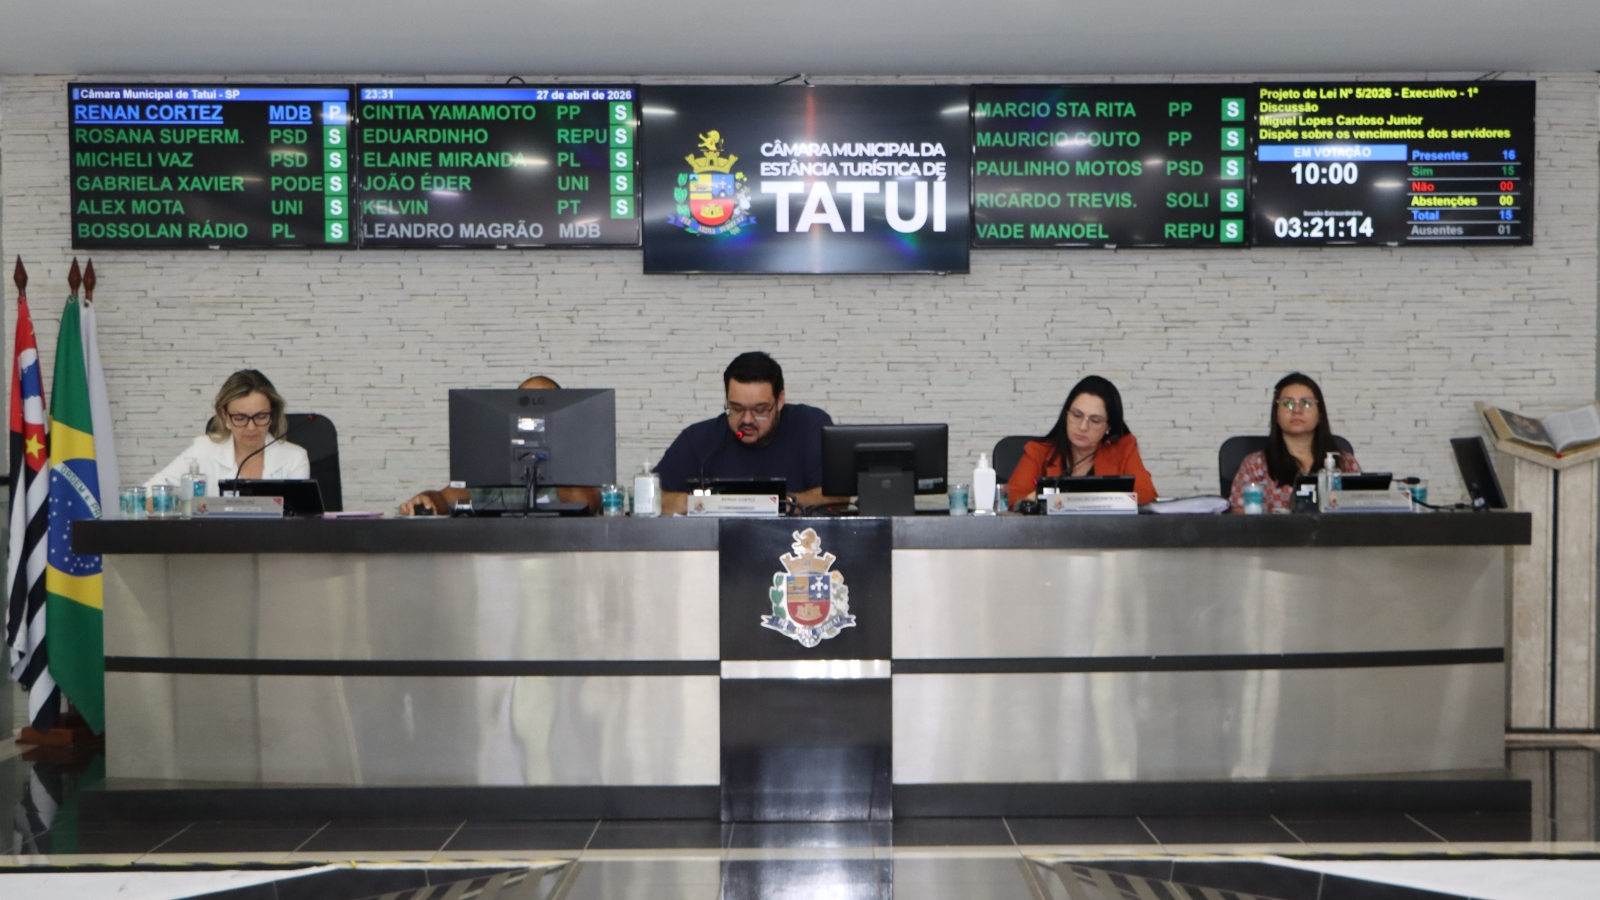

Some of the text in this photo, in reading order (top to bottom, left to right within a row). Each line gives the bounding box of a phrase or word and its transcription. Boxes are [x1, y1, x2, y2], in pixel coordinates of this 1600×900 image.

[81, 90, 120, 99] Câmara
[123, 89, 173, 100] Municipal
[176, 90, 188, 99] de
[225, 89, 240, 99] SP
[365, 90, 394, 99] 23:31
[536, 90, 632, 99] 27 de abril de 2026
[1260, 88, 1300, 101] Projeto
[1303, 88, 1317, 98] de
[1320, 88, 1337, 98] Lei
[1356, 88, 1392, 98] 5/2026
[1401, 88, 1457, 98] Executivo
[1467, 87, 1478, 98] 1ª
[74, 104, 341, 120] RENAN CORTEZ MDB P
[363, 105, 626, 120] CINTIA YAMAMOTO PP S
[976, 102, 1239, 117] MARCIO STA RITA PP S
[1260, 102, 1319, 112] Discussão
[1260, 114, 1423, 128] Miguel Lopes Cardoso Junior
[76, 129, 341, 144] ROSANA SUPERM. PSD S
[363, 129, 627, 144] EDUARDINHO REPU S
[976, 131, 1239, 147] MAURICIO COUTO PP S
[1260, 128, 1511, 142] Dispõe sobre os vencimentos dos servidores
[761, 140, 946, 157] CÂMARA MUNICIPAL DA
[1294, 146, 1372, 158] EM VOTAÇÃO
[1412, 150, 1516, 160] Presentes 16
[76, 152, 341, 168] MICHELI VAZ PSD S
[364, 152, 628, 167] ELAINE MIRANDA PL S
[761, 159, 946, 176] ESTÂNCIA TURÍSTICA DE
[976, 160, 1238, 176] PAULINHO MOTOS PSD S
[1291, 163, 1358, 185] 10:00
[1412, 166, 1514, 176] Sim 15
[76, 176, 342, 192] GABRIELA XAVIER PODE S
[363, 172, 628, 191] JOÃO ÉDER UNI S
[1412, 181, 1513, 192] Não 00
[77, 200, 342, 215] ALEX MOTA UNI S
[363, 200, 628, 215] KELVIN PT S
[761, 174, 947, 232] TATUÍ
[976, 192, 1238, 208] RICARDO TREVIS. SOLI S
[1411, 195, 1513, 207] Abstenções 00
[1411, 210, 1513, 220] Total 15
[78, 220, 343, 239] BOSSOLAN RÁDIO PL S
[364, 220, 601, 239] LEANDRO MAGRÃO MDB
[976, 223, 1238, 238] VADE MANOEL REPU S
[1274, 217, 1373, 238] 03:21:14
[1411, 225, 1510, 235] Ausentes 01
[532, 397, 545, 405] LG
[60, 466, 86, 493] ORDEM
[91, 503, 102, 518] PR
